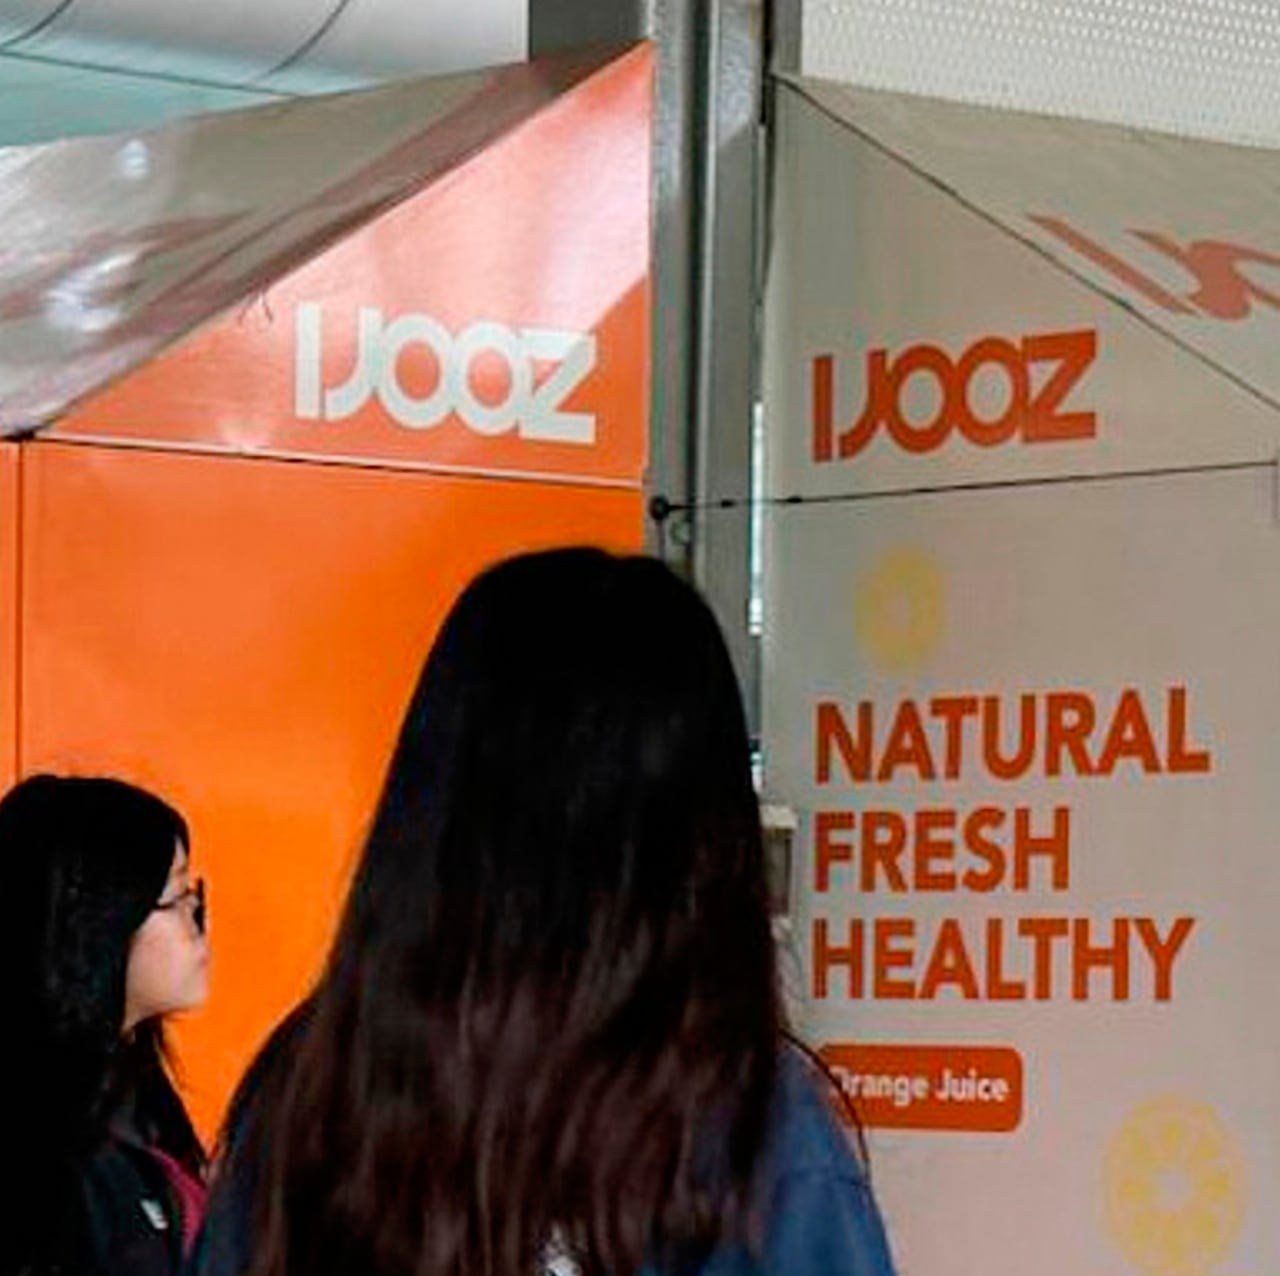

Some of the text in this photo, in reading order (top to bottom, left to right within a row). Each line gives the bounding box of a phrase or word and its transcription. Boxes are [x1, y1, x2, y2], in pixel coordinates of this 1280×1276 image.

[295, 304, 597, 445] IJOOZ
[813, 330, 1096, 462] IJOOZ
[816, 686, 1210, 784] NATURAL
[814, 806, 1069, 892] FRESH
[812, 917, 1195, 1002] HEALTHY
[935, 1067, 1010, 1102] Juice
